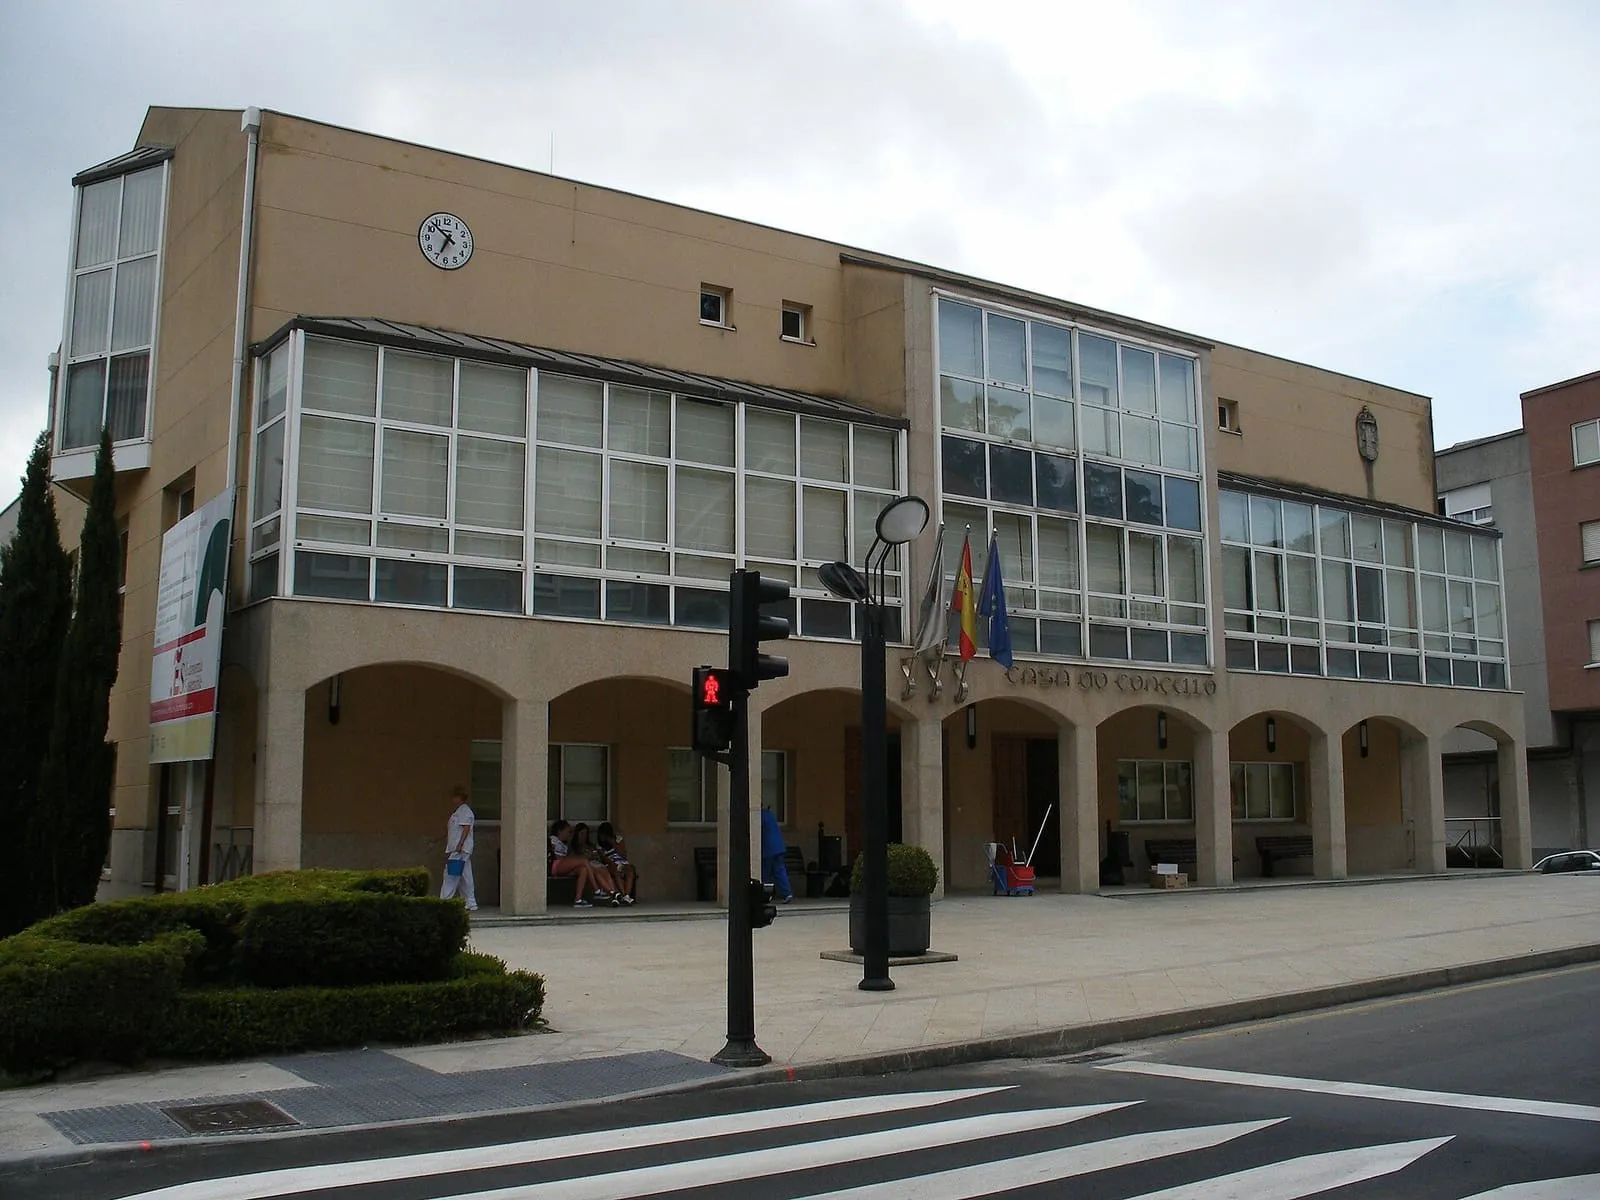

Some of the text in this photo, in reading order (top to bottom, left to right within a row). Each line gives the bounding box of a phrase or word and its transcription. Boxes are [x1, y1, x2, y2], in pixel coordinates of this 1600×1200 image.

[443, 218, 451, 226] 12
[428, 225, 435, 233] 10
[463, 241, 468, 249] 3
[434, 252, 440, 260] 7
[443, 257, 448, 265] 6
[1004, 666, 1070, 688] CASA
